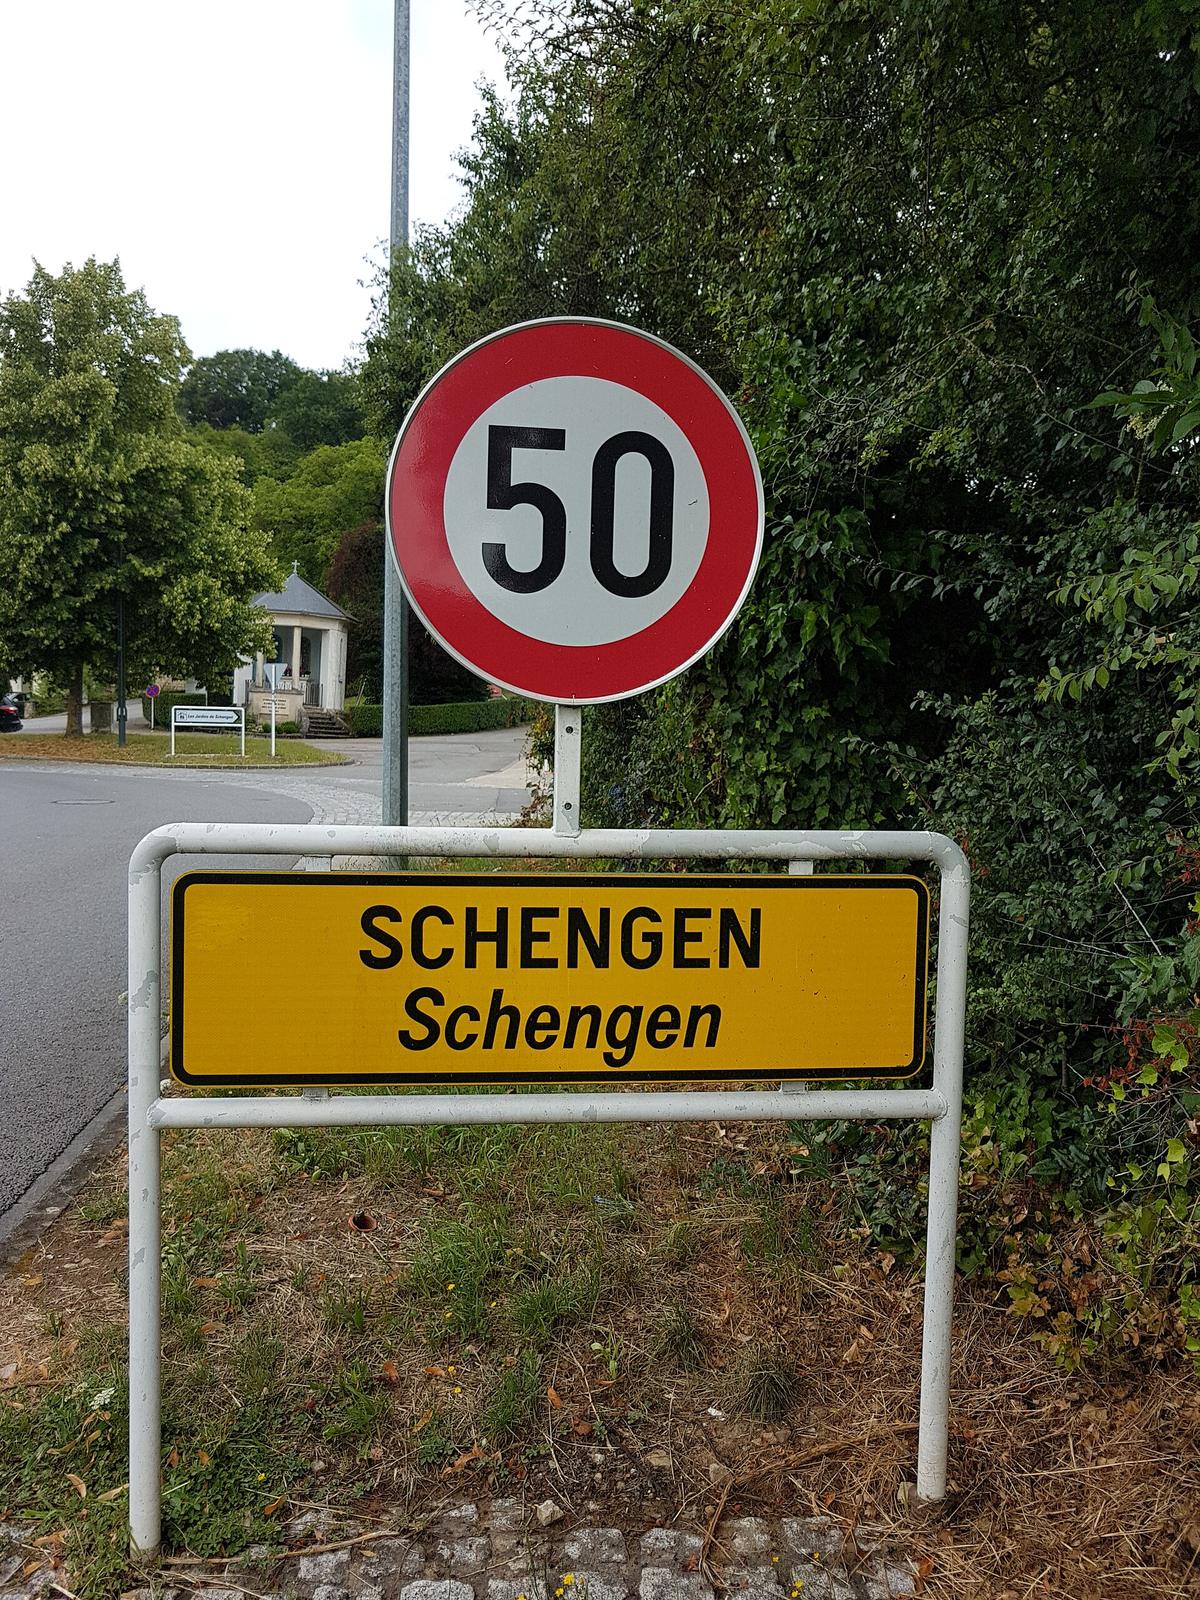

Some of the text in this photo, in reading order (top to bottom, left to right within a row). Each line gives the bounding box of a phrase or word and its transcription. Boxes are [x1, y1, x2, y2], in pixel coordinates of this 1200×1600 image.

[481, 424, 675, 599] 50
[359, 904, 762, 969] SCHENGEN
[398, 986, 722, 1068] Schengen
